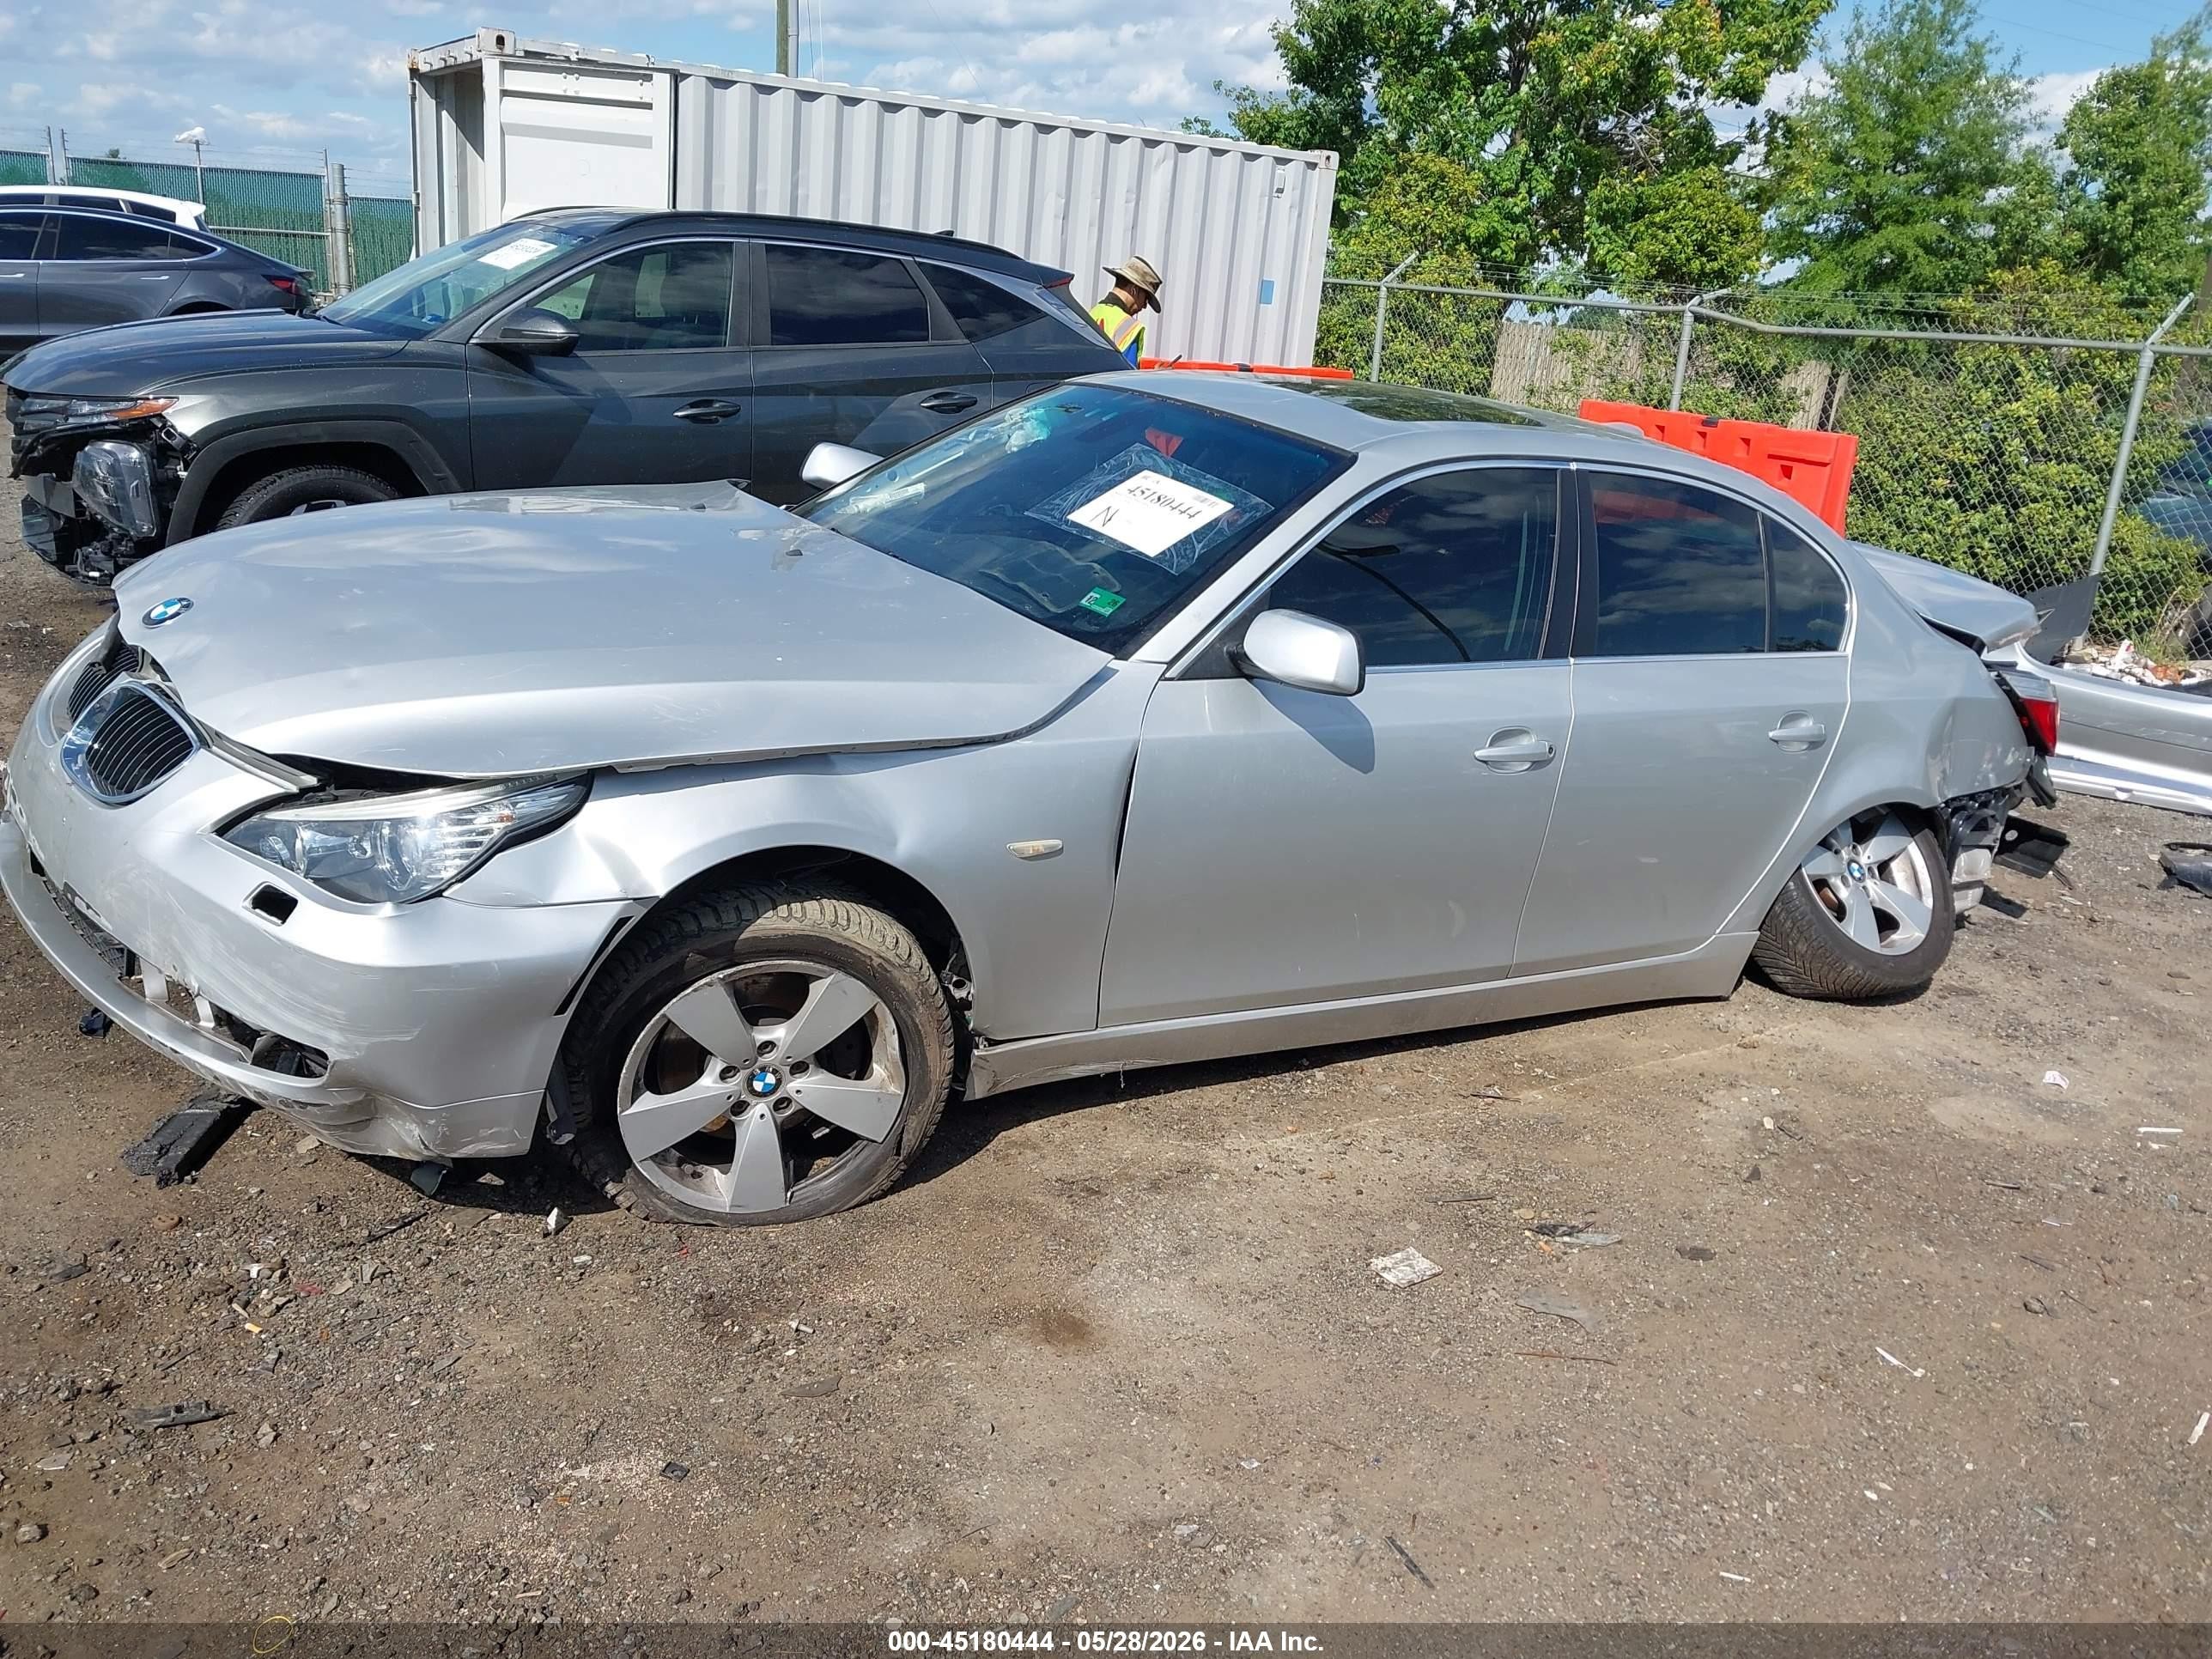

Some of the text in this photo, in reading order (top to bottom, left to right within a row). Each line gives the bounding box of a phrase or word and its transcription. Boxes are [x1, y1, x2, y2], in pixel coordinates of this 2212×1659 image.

[1127, 484, 1202, 520] 45180444
[1090, 505, 1120, 527] N
[1085, 594, 1098, 605] 12
